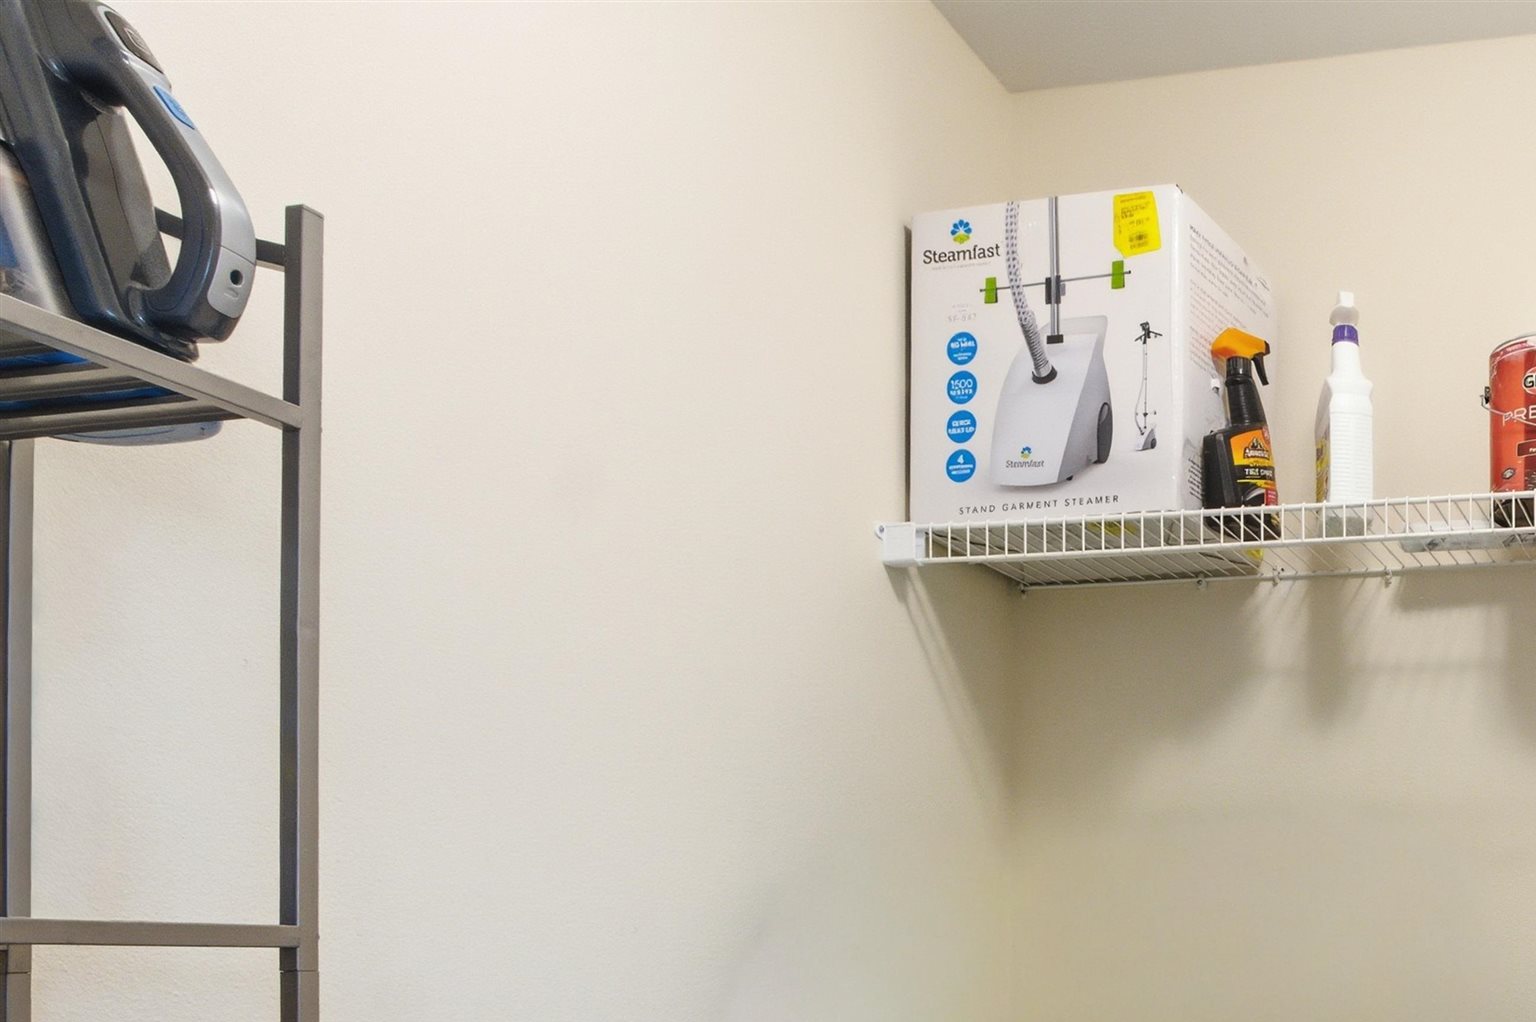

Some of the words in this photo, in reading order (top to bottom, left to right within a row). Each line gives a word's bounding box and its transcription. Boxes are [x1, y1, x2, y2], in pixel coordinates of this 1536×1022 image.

[922, 243, 1001, 265] Steamfast
[957, 454, 964, 464] 4
[959, 505, 996, 515] STAND
[1002, 500, 1058, 512] GARMENT
[1064, 494, 1119, 507] STEAMER
